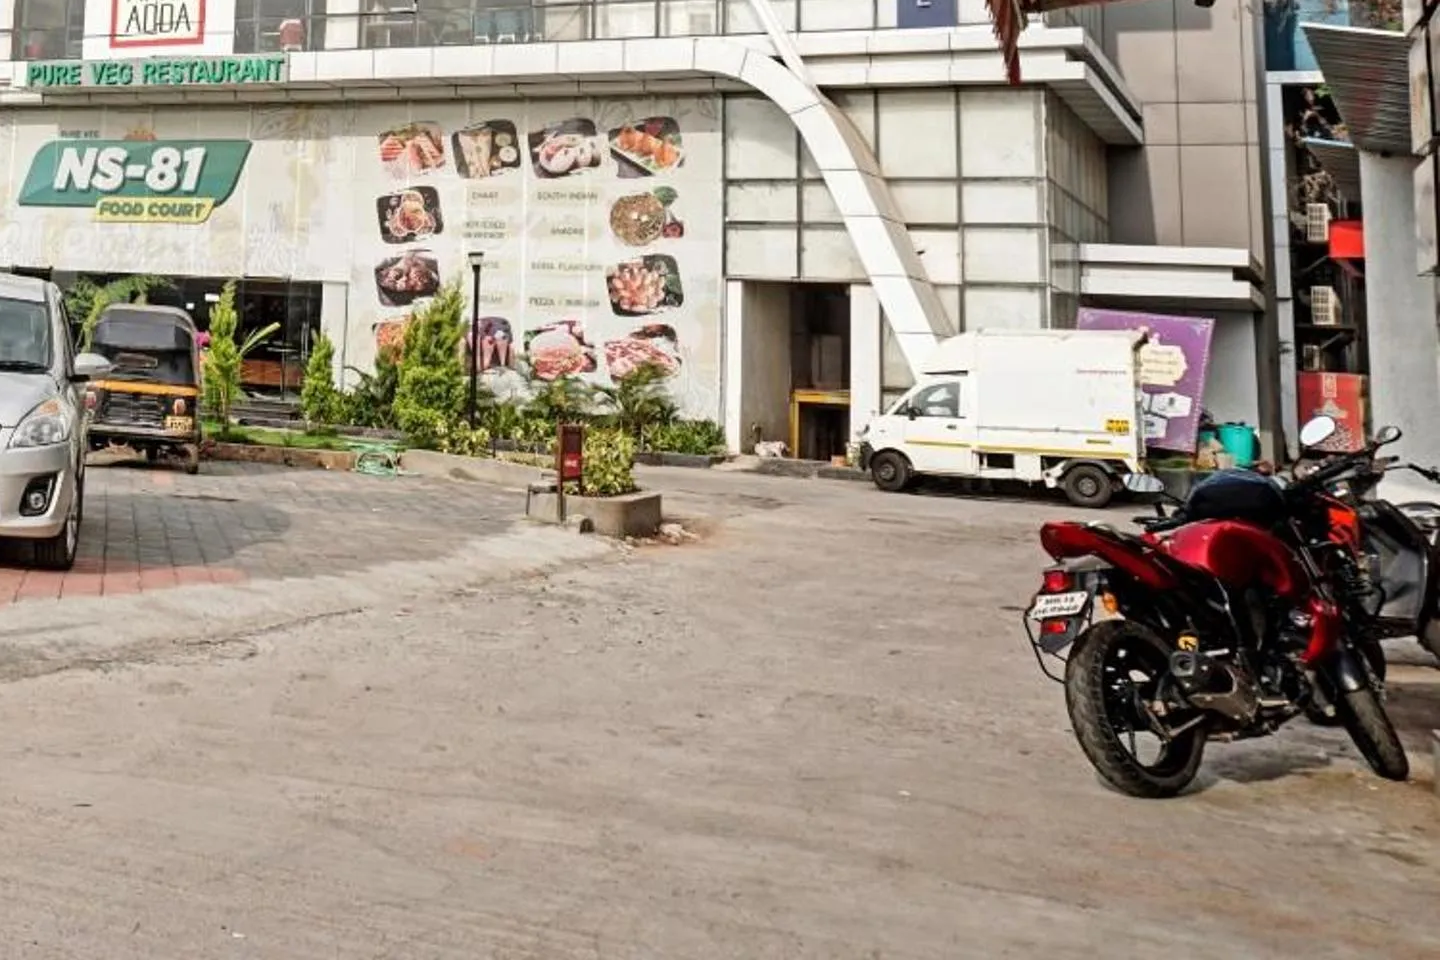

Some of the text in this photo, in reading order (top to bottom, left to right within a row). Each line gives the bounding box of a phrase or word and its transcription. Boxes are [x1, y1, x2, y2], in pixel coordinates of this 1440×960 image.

[125, 1, 192, 34] ADDA
[27, 58, 285, 86] PURE VEG RESTAURANT
[52, 146, 206, 195] NS-81
[99, 201, 206, 218] FOOD COURT
